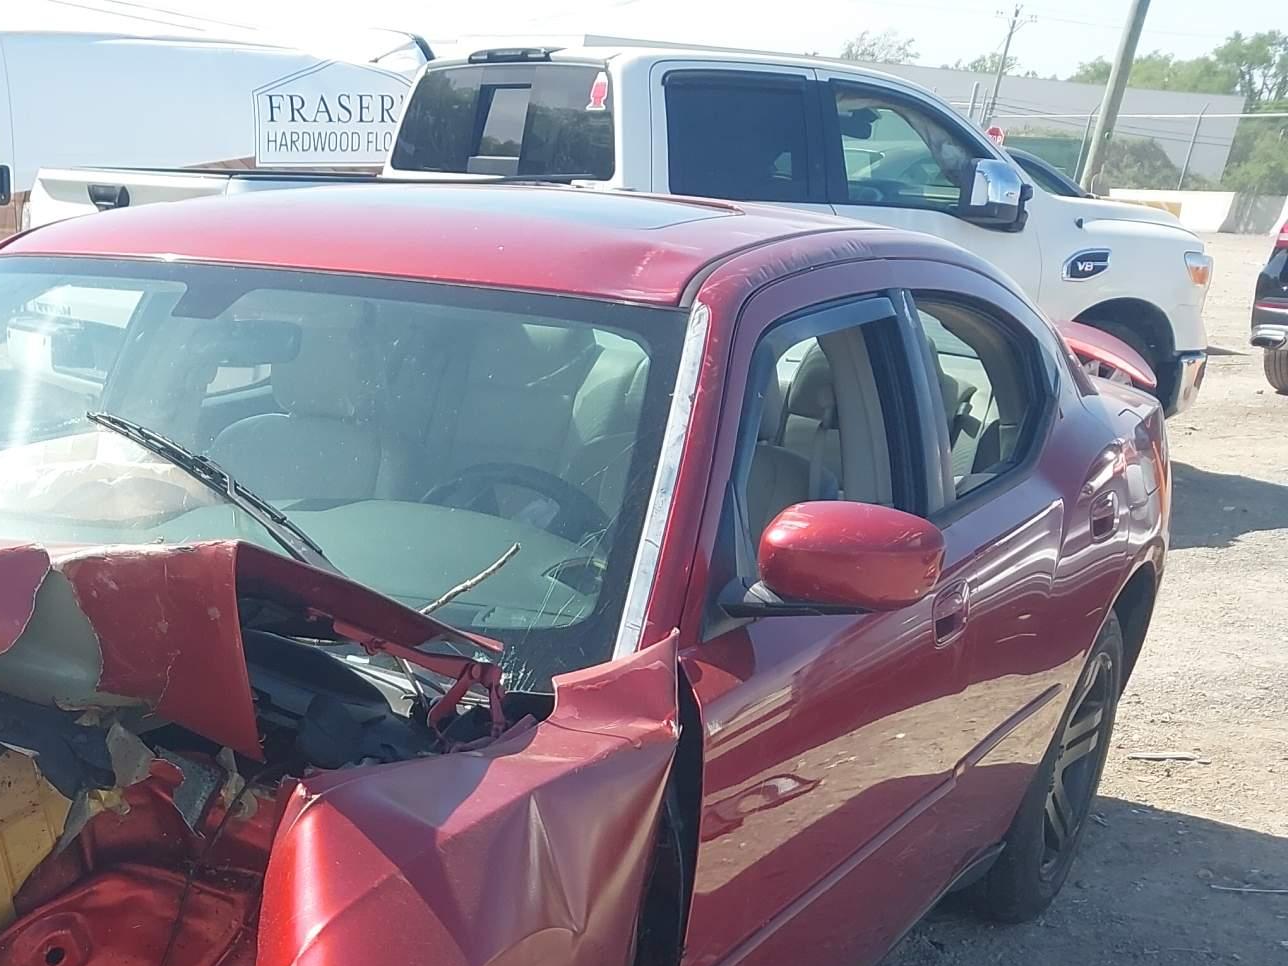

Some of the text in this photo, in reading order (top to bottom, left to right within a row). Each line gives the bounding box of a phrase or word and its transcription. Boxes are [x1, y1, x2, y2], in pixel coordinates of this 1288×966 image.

[266, 94, 404, 123] FRASER'
[267, 131, 393, 152] HARDWOOD FLO
[1077, 261, 1094, 272] V8
